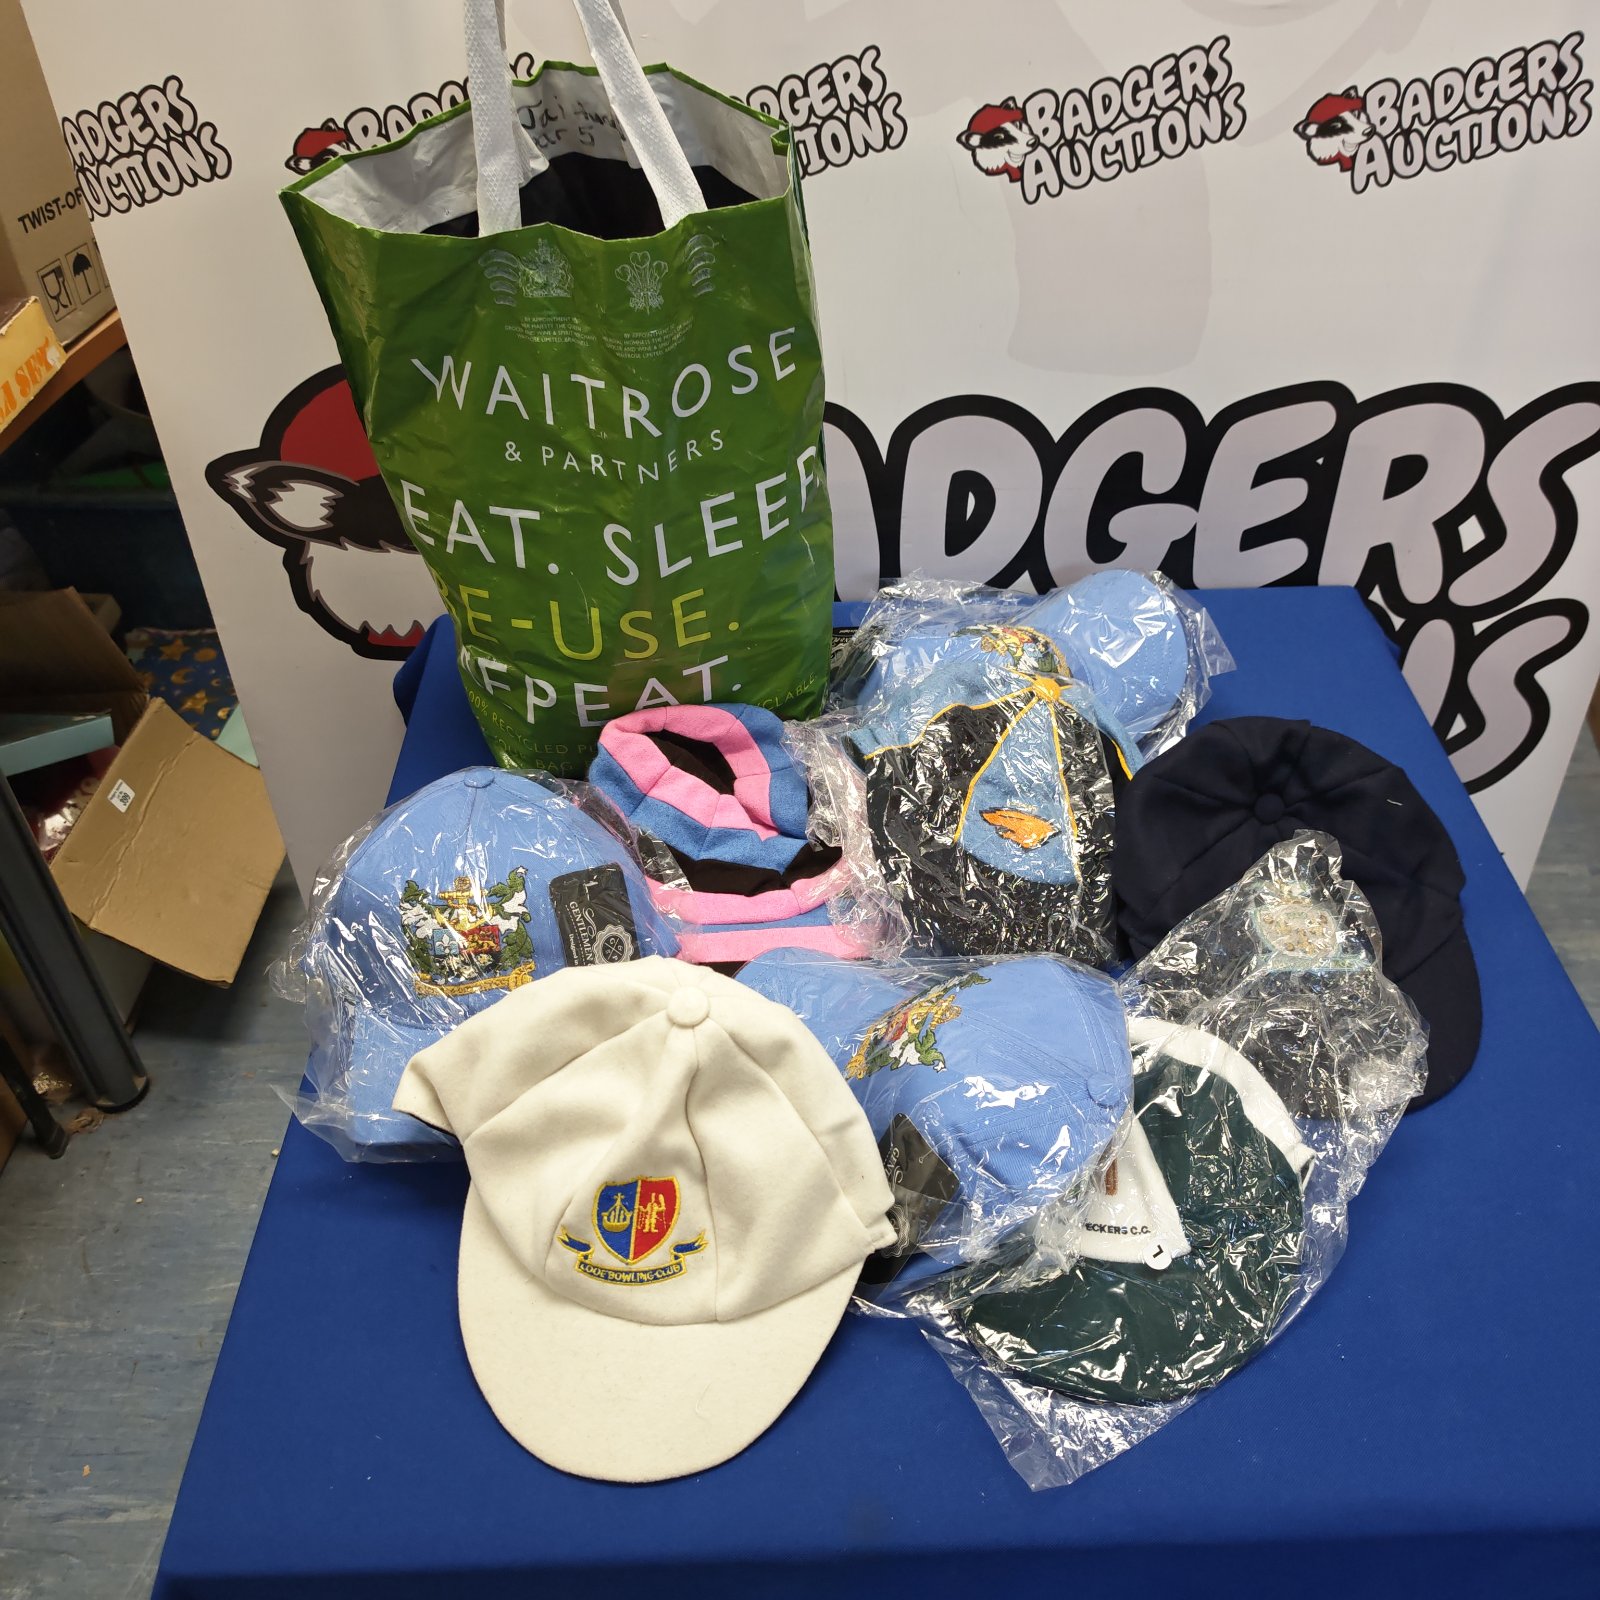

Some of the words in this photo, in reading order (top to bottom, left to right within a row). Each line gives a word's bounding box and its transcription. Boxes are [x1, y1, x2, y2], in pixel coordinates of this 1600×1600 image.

[730, 44, 887, 128] DGERS
[1021, 35, 1231, 146] BADGERS
[1364, 30, 1584, 138] BADGERS
[76, 121, 233, 223] UCTIONS
[578, 125, 595, 146] 5
[1020, 83, 1247, 205] AUCTIONS
[1348, 79, 1594, 194] AUCTIONS
[411, 327, 796, 439] WAITROSE
[505, 440, 523, 463] &
[541, 429, 725, 484] PARTNERS
[401, 479, 560, 575] EAT.
[492, 713, 569, 754] RECYCLED
[569, 901, 594, 961] GENTLEMEN
